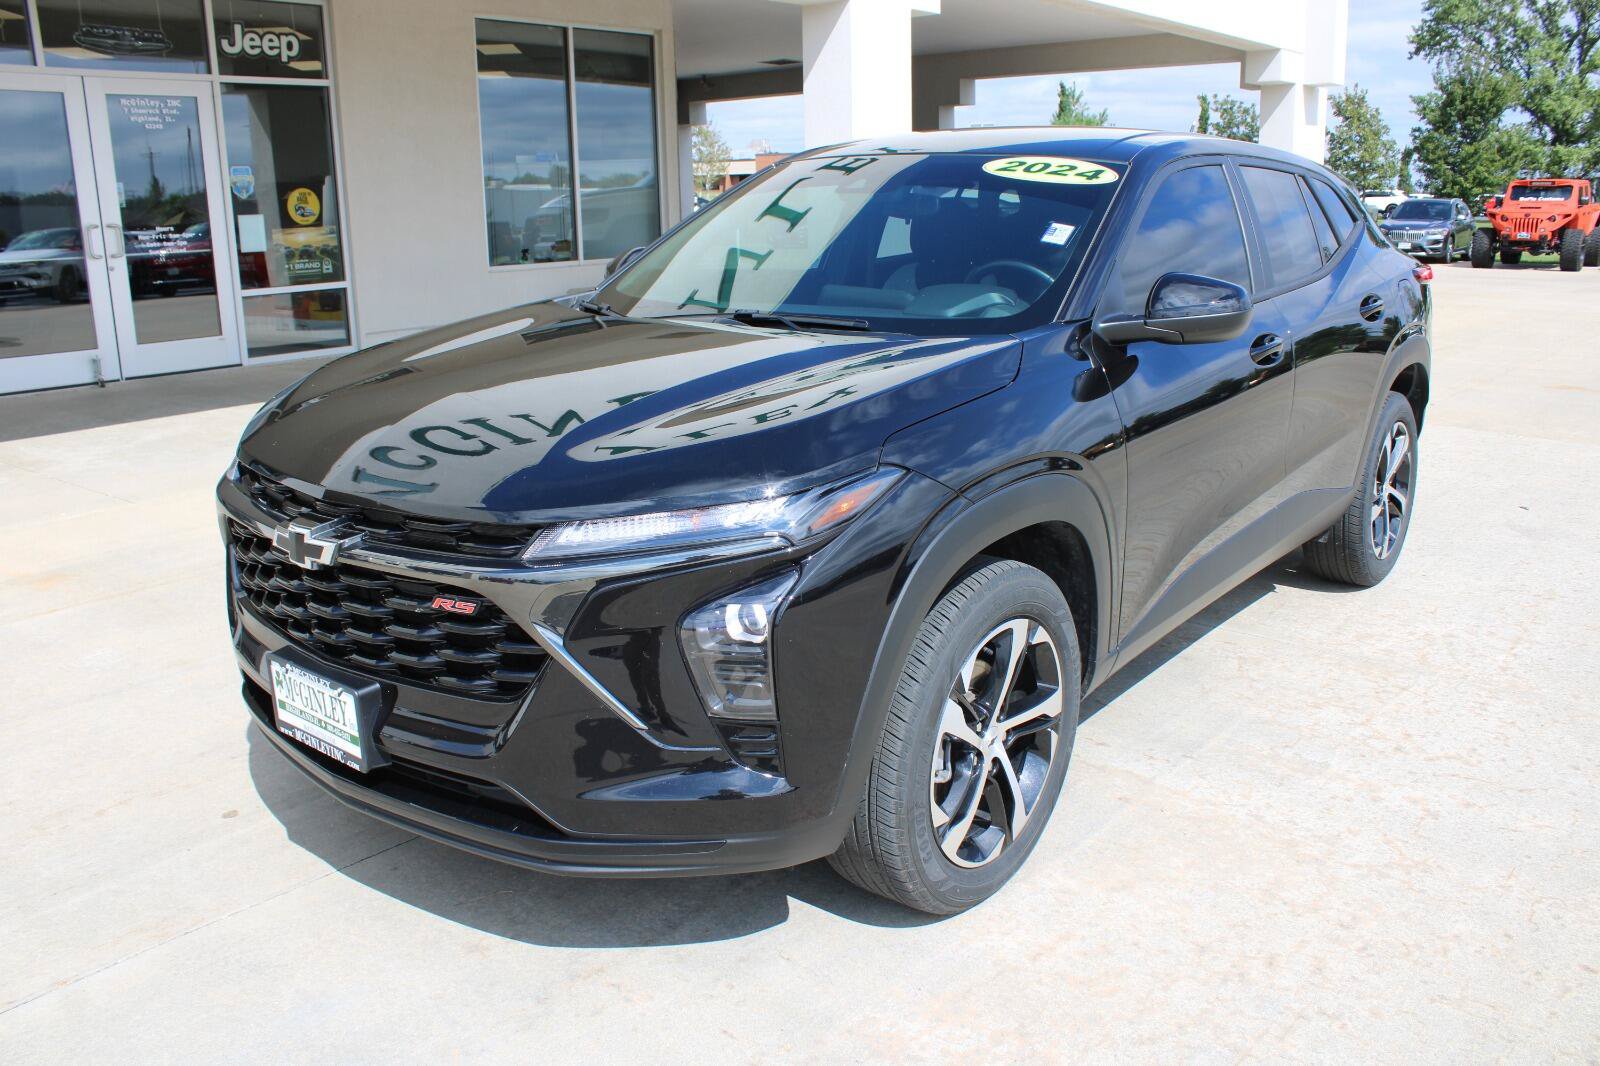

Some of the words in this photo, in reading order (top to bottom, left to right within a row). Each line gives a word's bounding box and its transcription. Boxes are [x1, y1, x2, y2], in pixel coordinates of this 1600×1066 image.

[222, 24, 299, 62] Jeep
[994, 160, 1105, 181] 2024
[295, 262, 321, 270] BRAND
[431, 597, 476, 613] RS
